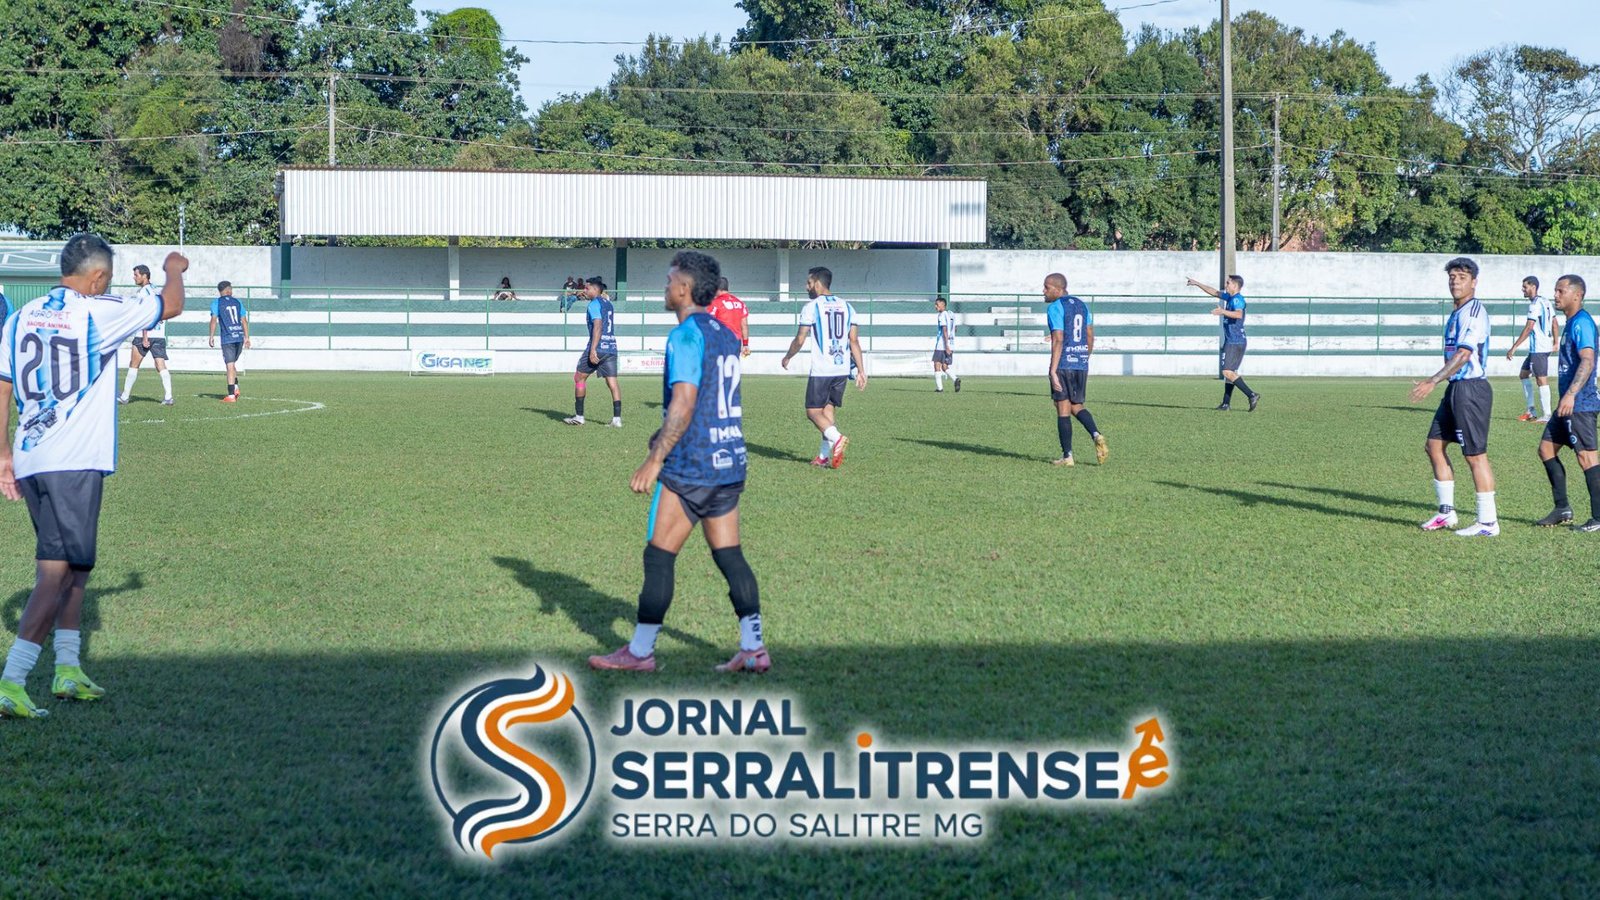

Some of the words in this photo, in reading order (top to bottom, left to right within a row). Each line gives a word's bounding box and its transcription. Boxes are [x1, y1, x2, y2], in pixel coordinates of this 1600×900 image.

[226, 305, 239, 324] 11
[825, 311, 845, 339] 10
[1073, 314, 1083, 342] 8
[20, 332, 81, 401] 20
[717, 354, 742, 419] 12
